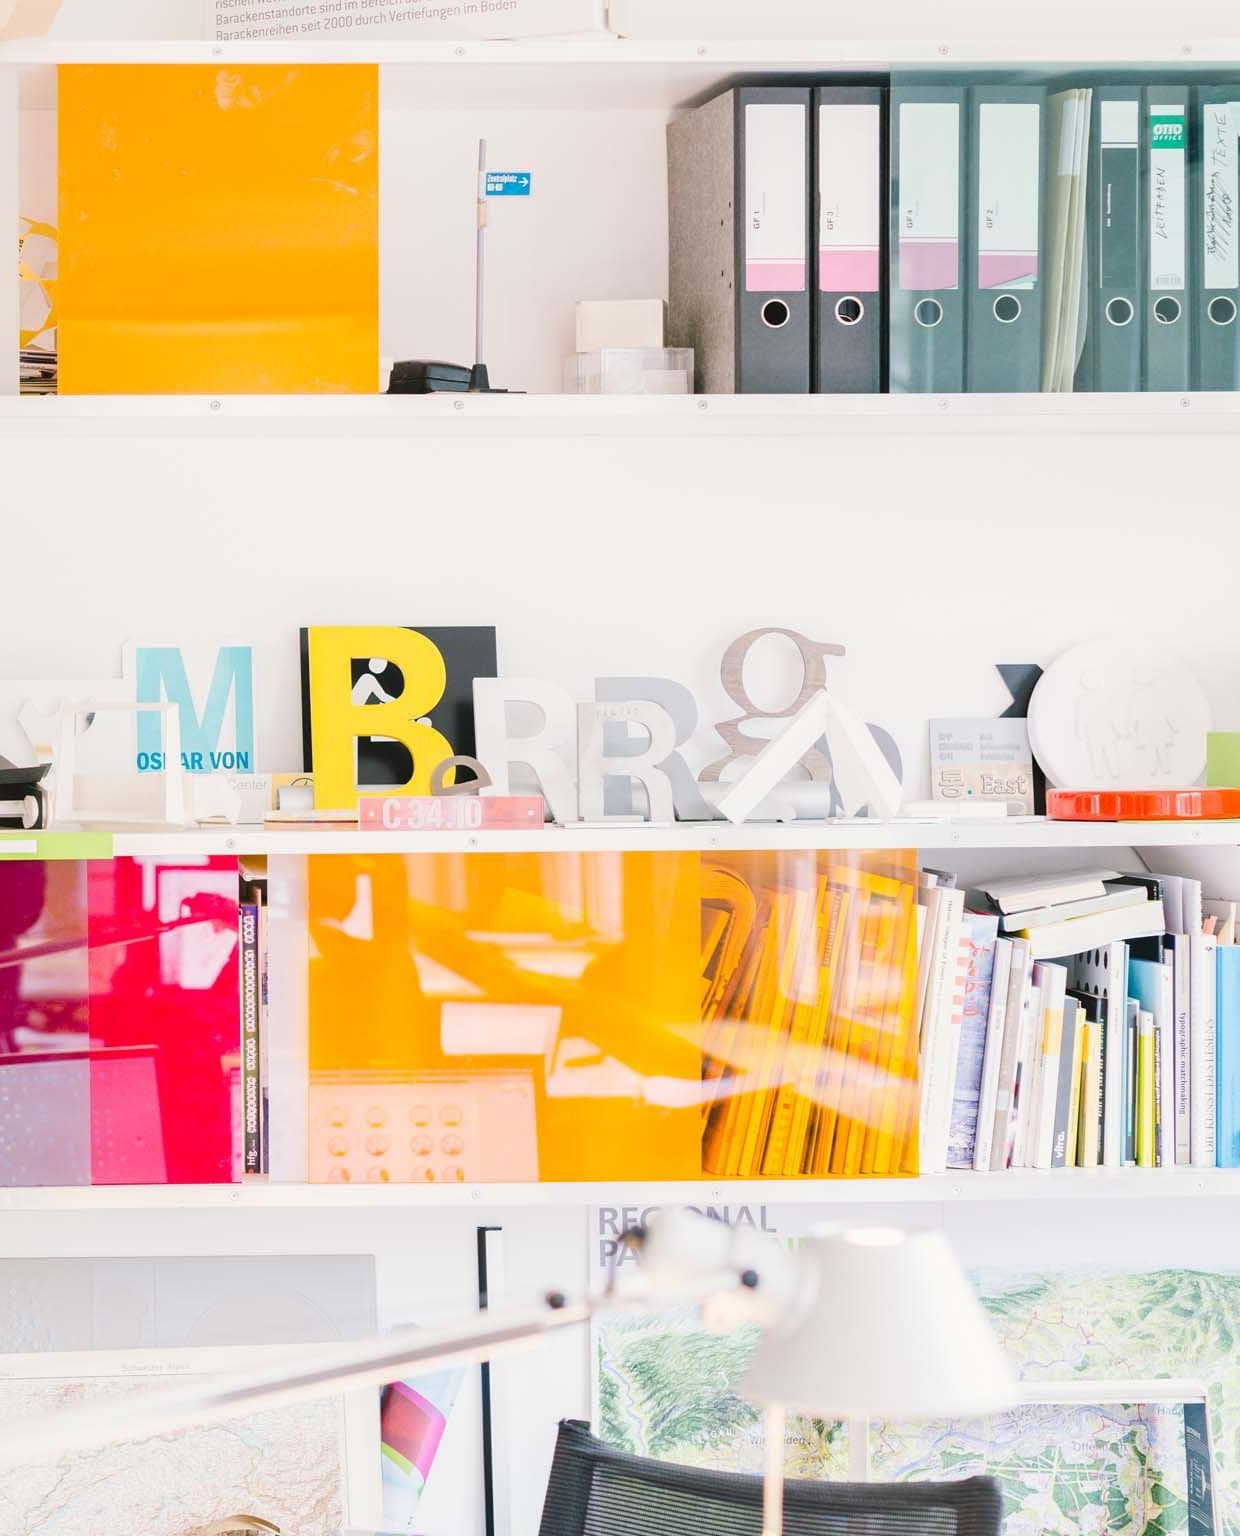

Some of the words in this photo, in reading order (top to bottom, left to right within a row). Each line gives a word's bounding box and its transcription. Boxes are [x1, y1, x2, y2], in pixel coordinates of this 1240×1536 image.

[216, 5, 316, 25] Barackenstandorte
[319, 1, 342, 14] sind
[344, 0, 358, 10] im
[216, 23, 299, 41] Barackenreihen
[301, 20, 321, 32] seit
[324, 15, 353, 30] 2000
[355, 12, 387, 25] durch
[389, 6, 460, 22] Vertiefungen
[463, 2, 478, 15] im
[481, 0, 517, 13] Boden
[827, 217, 834, 230] GF
[136, 646, 254, 773] M
[308, 626, 456, 810] B
[136, 752, 203, 769] OSAR
[210, 752, 248, 769] VON
[383, 798, 401, 829] C
[1177, 1012, 1187, 1058] typographic
[1177, 1060, 1187, 1115] matchmaking
[600, 1206, 777, 1235] RENAL
